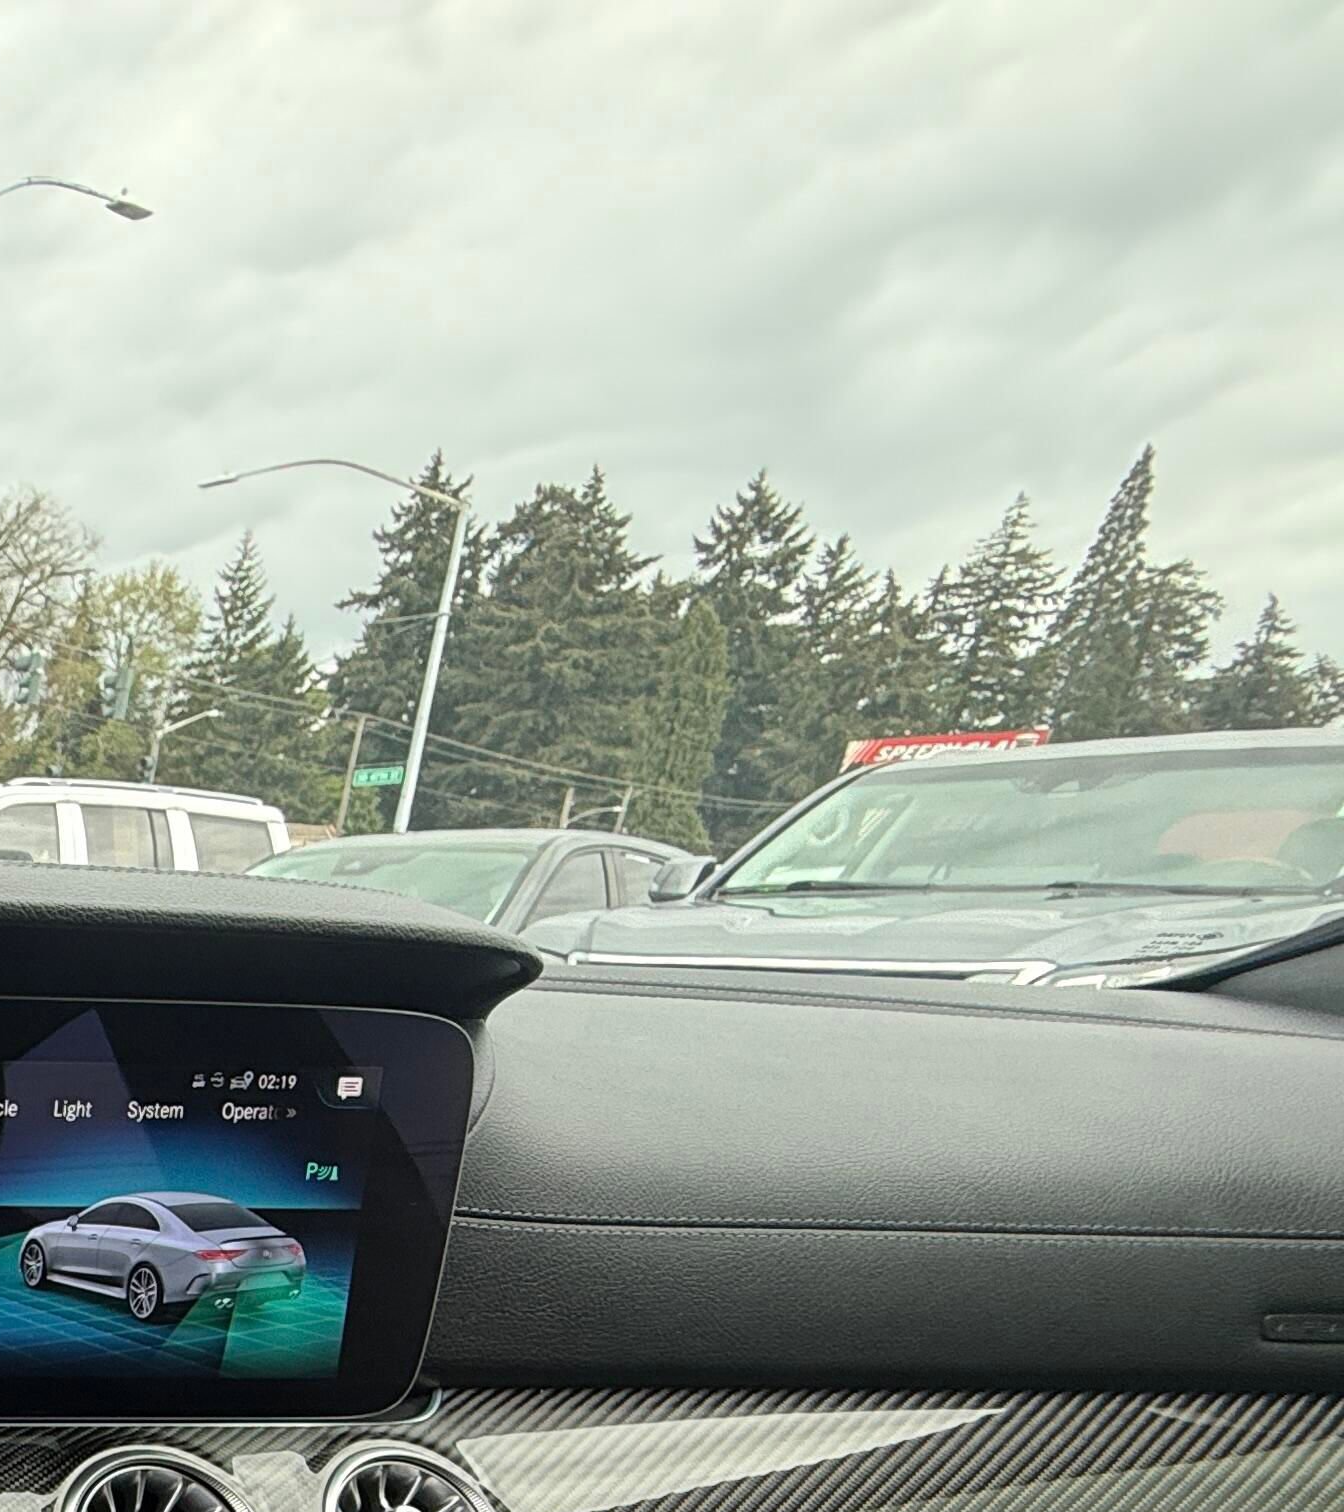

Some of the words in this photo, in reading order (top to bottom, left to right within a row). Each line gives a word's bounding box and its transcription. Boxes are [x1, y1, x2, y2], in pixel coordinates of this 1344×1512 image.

[258, 1074, 298, 1090] 02:19
[52, 1101, 93, 1121] Light
[127, 1102, 185, 1122] System
